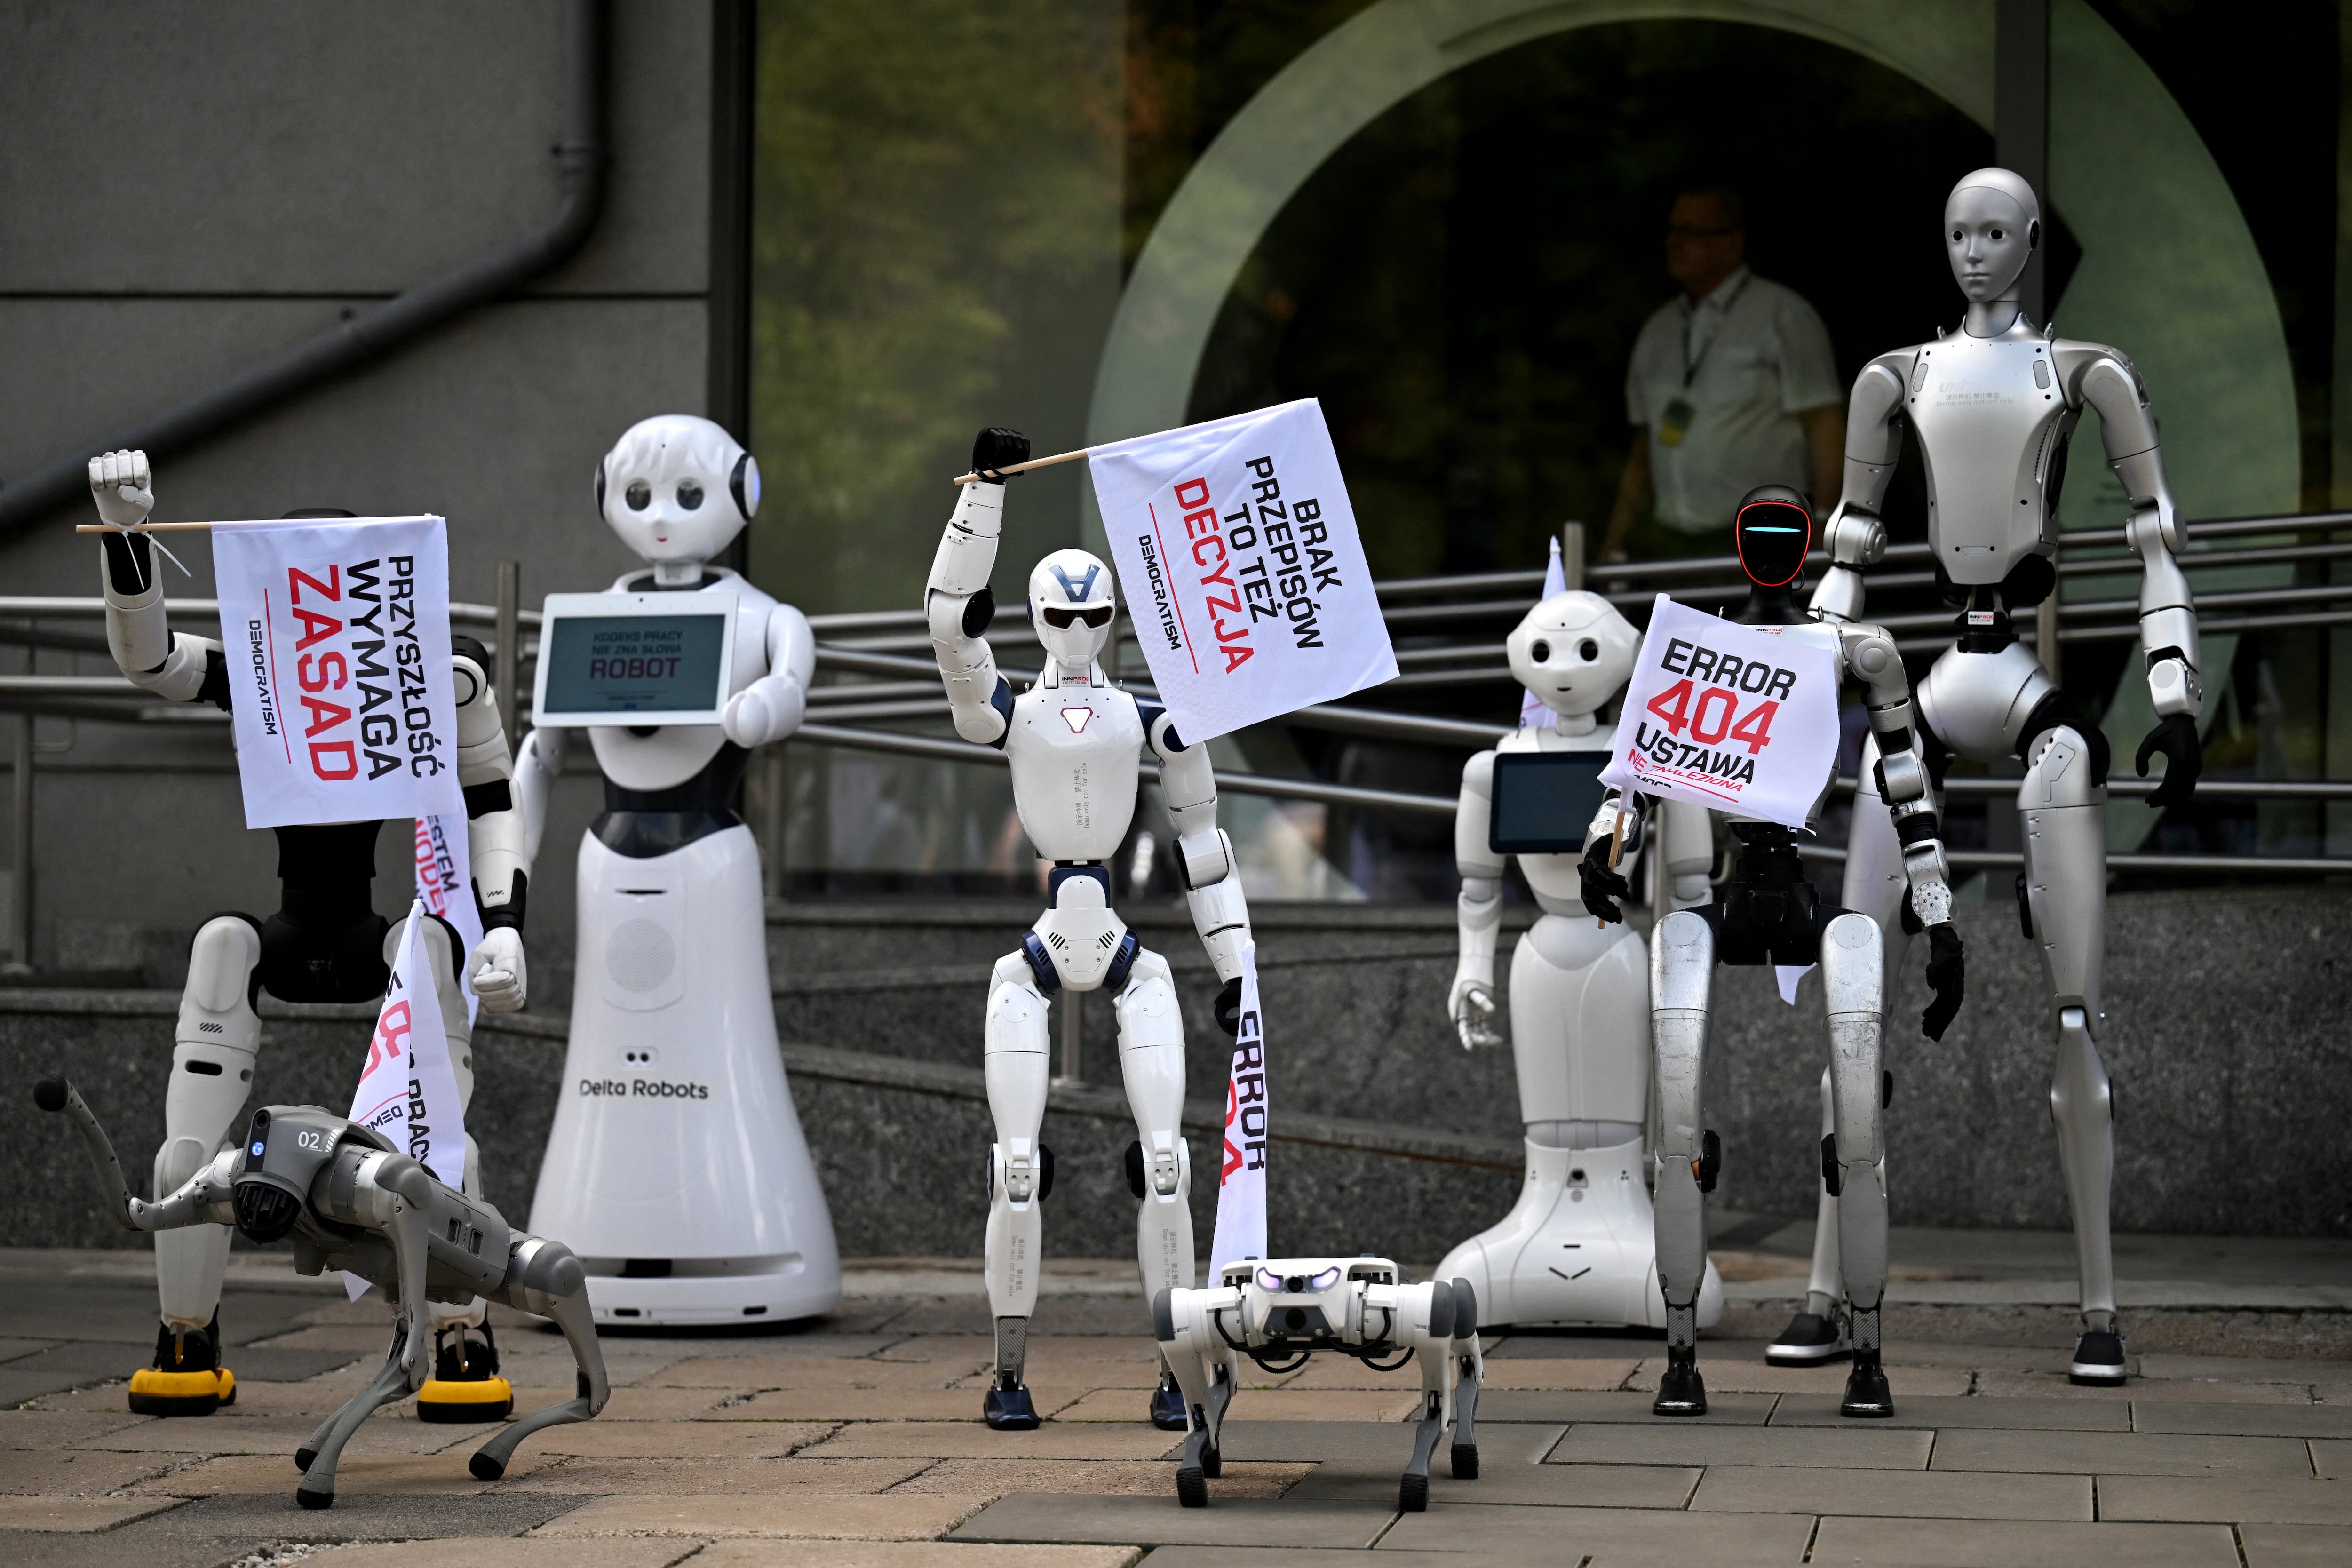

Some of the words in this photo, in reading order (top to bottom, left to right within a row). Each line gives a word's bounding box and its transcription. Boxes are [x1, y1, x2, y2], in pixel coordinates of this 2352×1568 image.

[1174, 477, 1254, 674] DECYZJA
[1224, 503, 1256, 550] TO
[1240, 556, 1283, 623] TEŻ
[1245, 456, 1324, 648] PRZEPISÓW
[1293, 498, 1342, 593] BRAK
[1139, 535, 1181, 650] DEMOCRATISM
[249, 620, 277, 735] DEMOCRATISM
[288, 565, 358, 781] ZASAD
[347, 559, 402, 780] WYMAGA
[389, 556, 445, 778] PRZYSZŁOŚĆ
[590, 657, 681, 678] ROBOT
[614, 645, 637, 654] ZNA
[644, 631, 683, 640] PRACY
[1661, 638, 1796, 700] ERROR
[1636, 722, 1755, 784] USTAWA
[1646, 679, 1780, 755] 404
[1646, 765, 1743, 792] ZNALEZIONA
[427, 815, 460, 892] ESTEM
[409, 1079, 430, 1163] PRAC
[579, 1079, 626, 1096] Delta
[633, 1079, 708, 1099] Robots
[1235, 1011, 1266, 1170] ERROR
[298, 1131, 319, 1149] 02
